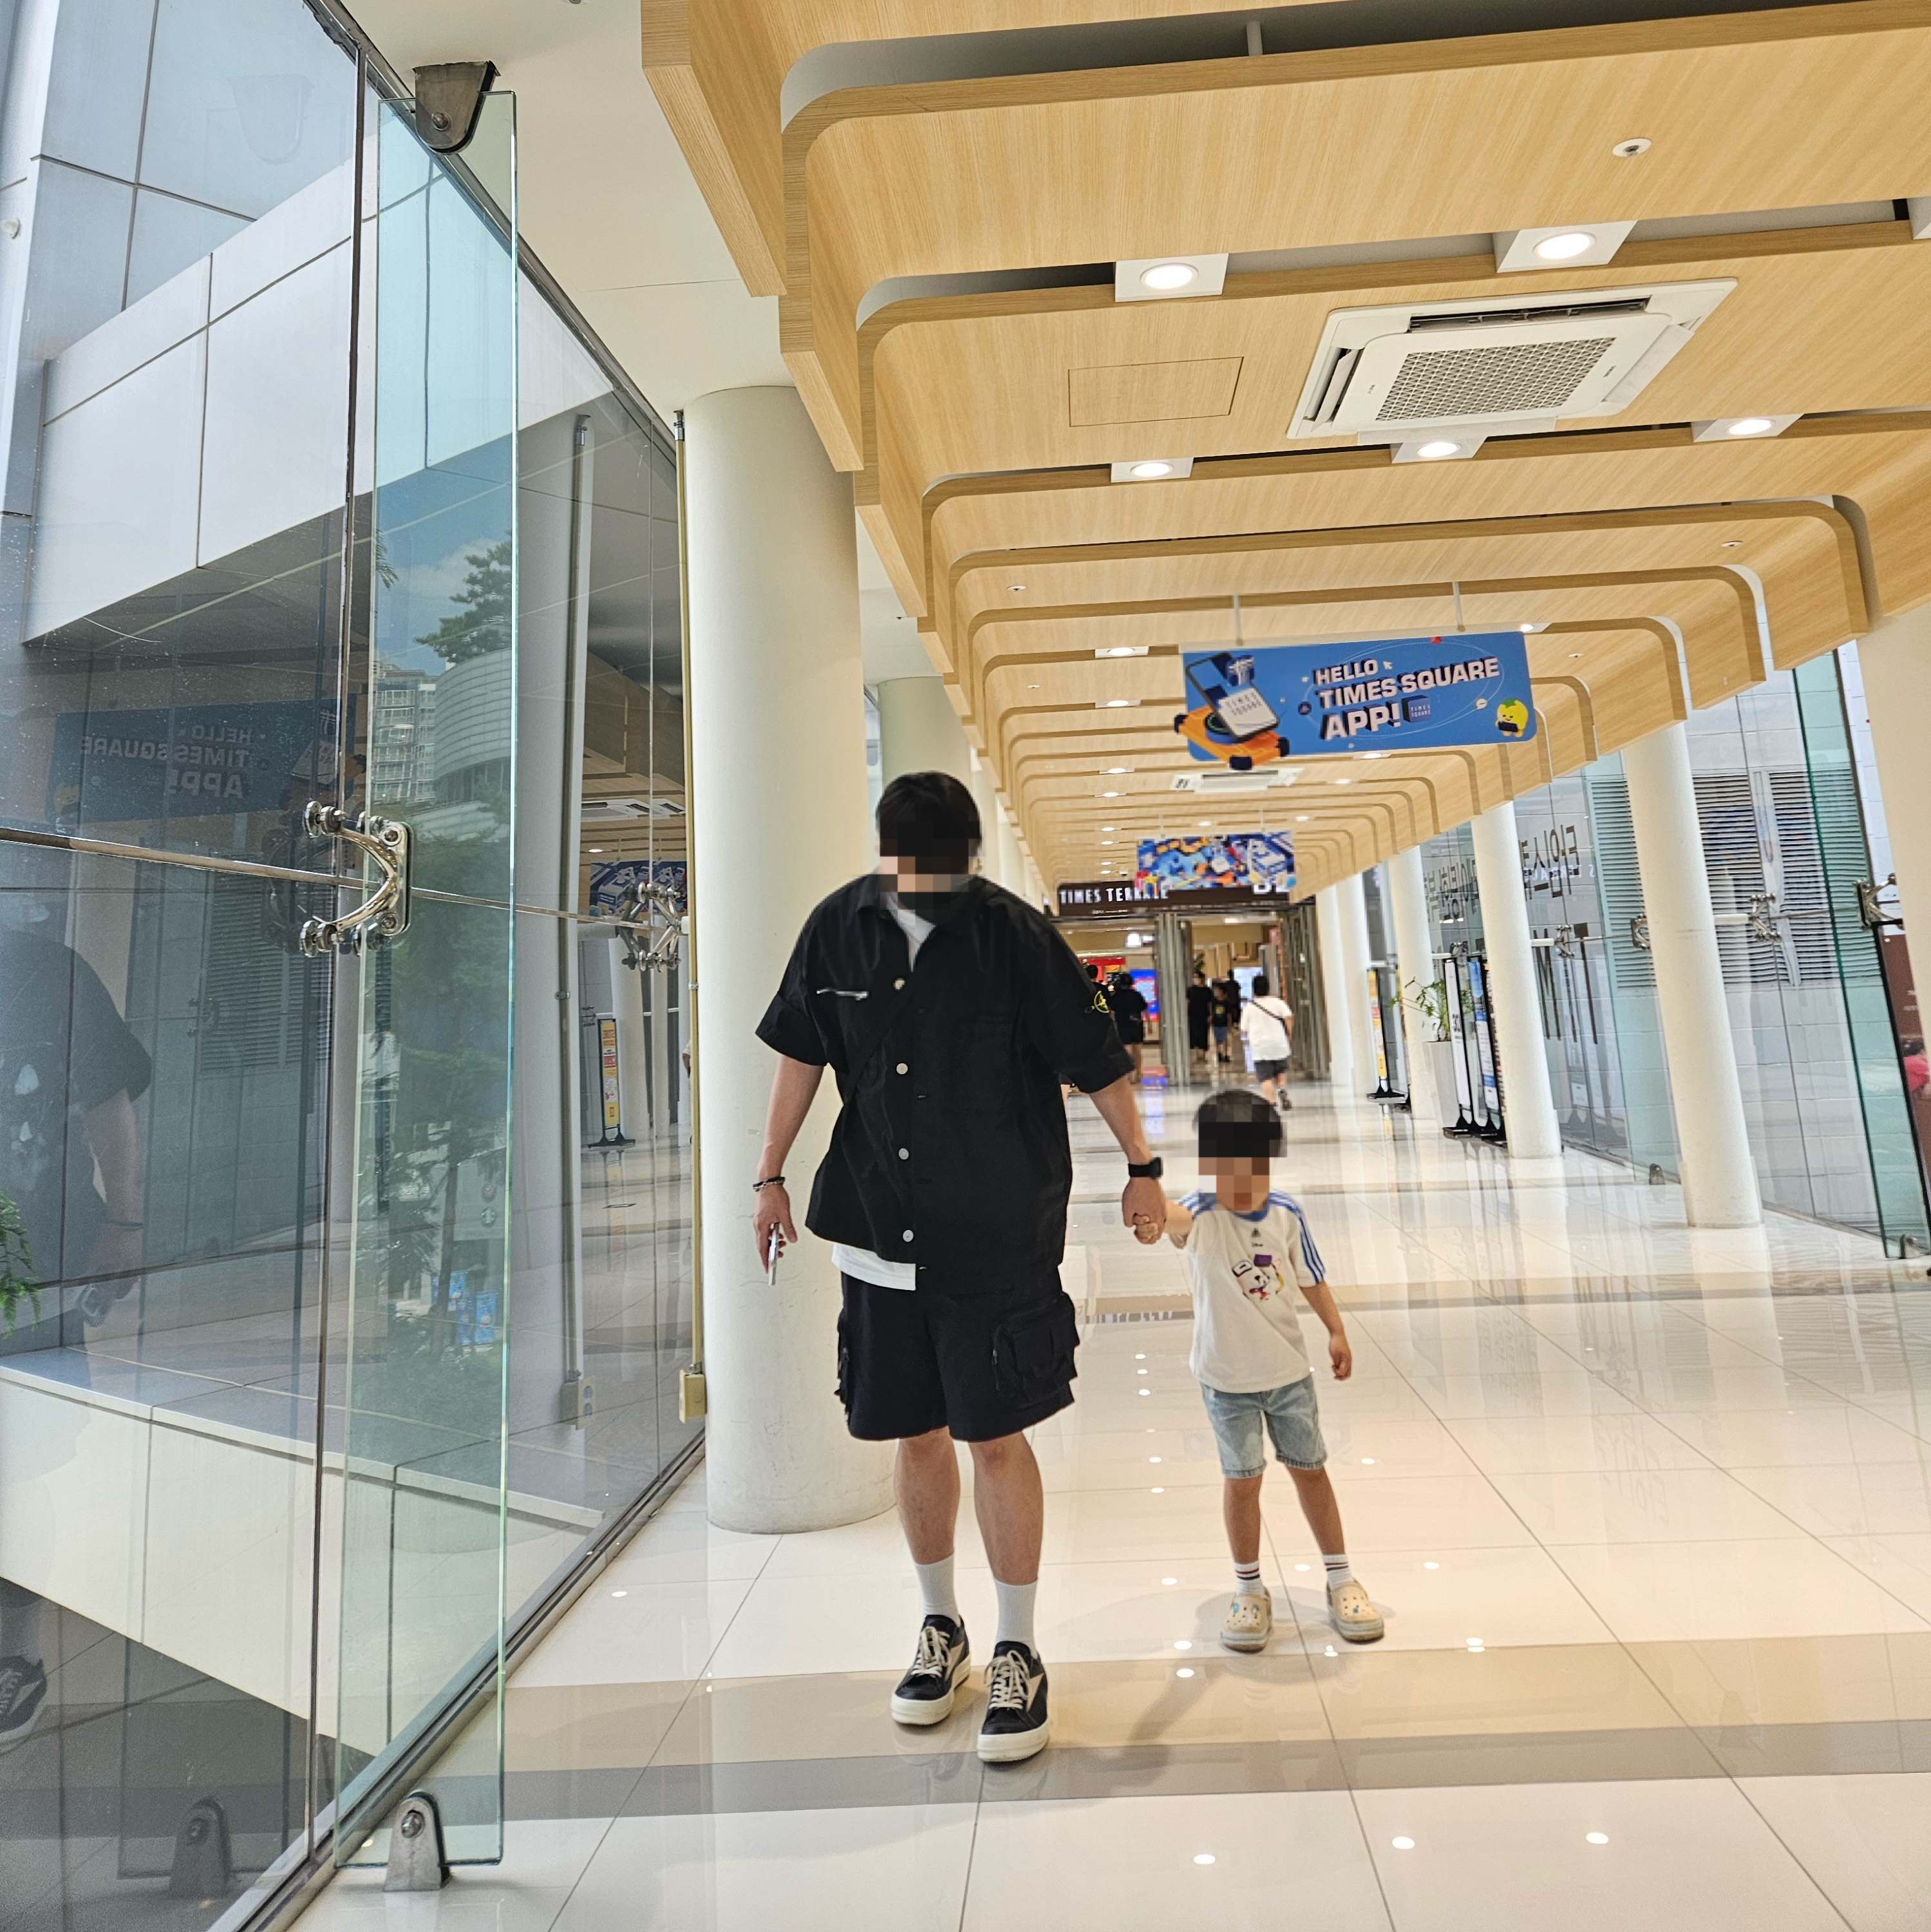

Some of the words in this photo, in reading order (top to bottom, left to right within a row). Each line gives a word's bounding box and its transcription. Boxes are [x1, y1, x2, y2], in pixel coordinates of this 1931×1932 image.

[1314, 658, 1379, 685] HELLO
[1317, 677, 1398, 709] TIMES
[1399, 656, 1500, 693] SQUARE
[1321, 701, 1401, 740] APP!
[1059, 887, 1101, 904] TIMES
